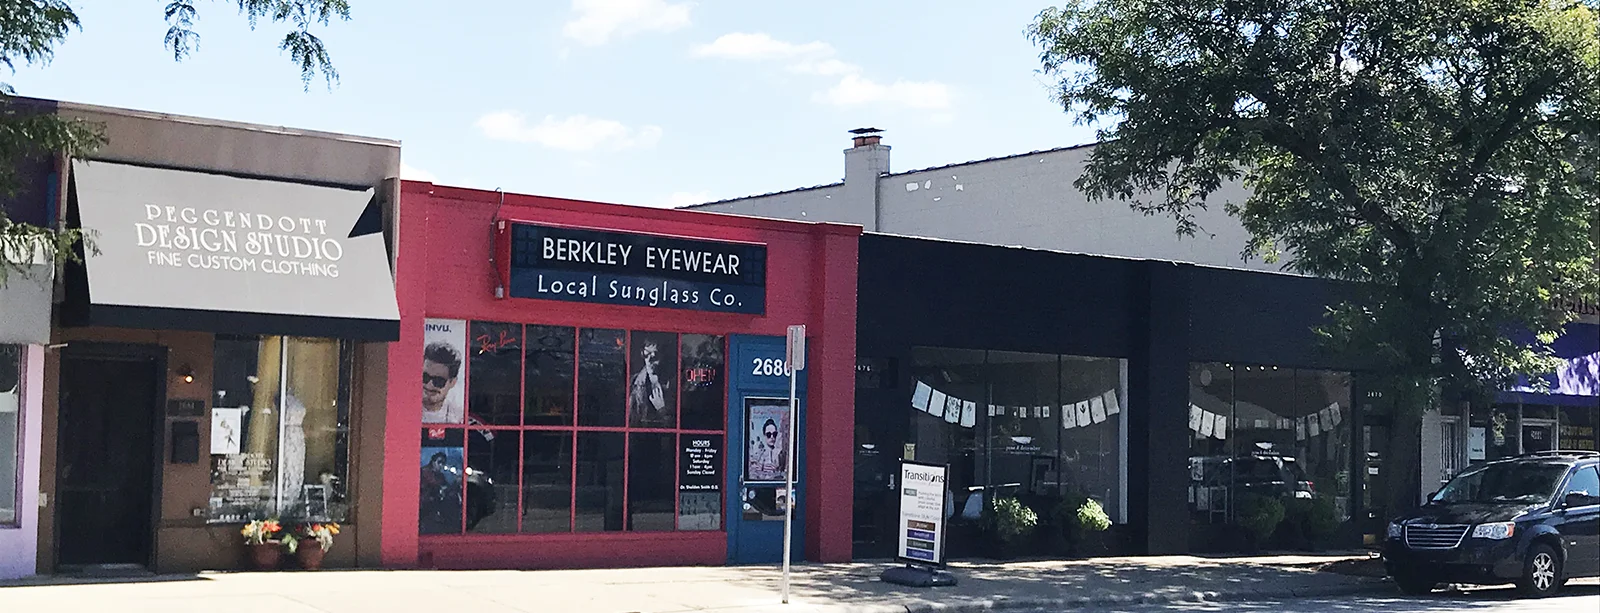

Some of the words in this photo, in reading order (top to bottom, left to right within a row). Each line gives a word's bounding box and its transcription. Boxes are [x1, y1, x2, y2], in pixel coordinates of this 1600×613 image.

[145, 203, 327, 235] PEGGENDOTT
[134, 222, 238, 253] DESIGN
[244, 231, 343, 261] STUDIO
[543, 237, 632, 266] BERKLEY
[646, 246, 740, 275] EYEWEAR
[147, 251, 182, 267] FINE
[187, 254, 257, 272] CUSTOM
[260, 259, 339, 278] CLOTHING
[538, 274, 597, 298] Local
[608, 280, 699, 307] Sunglass
[709, 288, 742, 307] Co.
[685, 368, 716, 382] OPEN
[904, 469, 945, 483] Transitions
